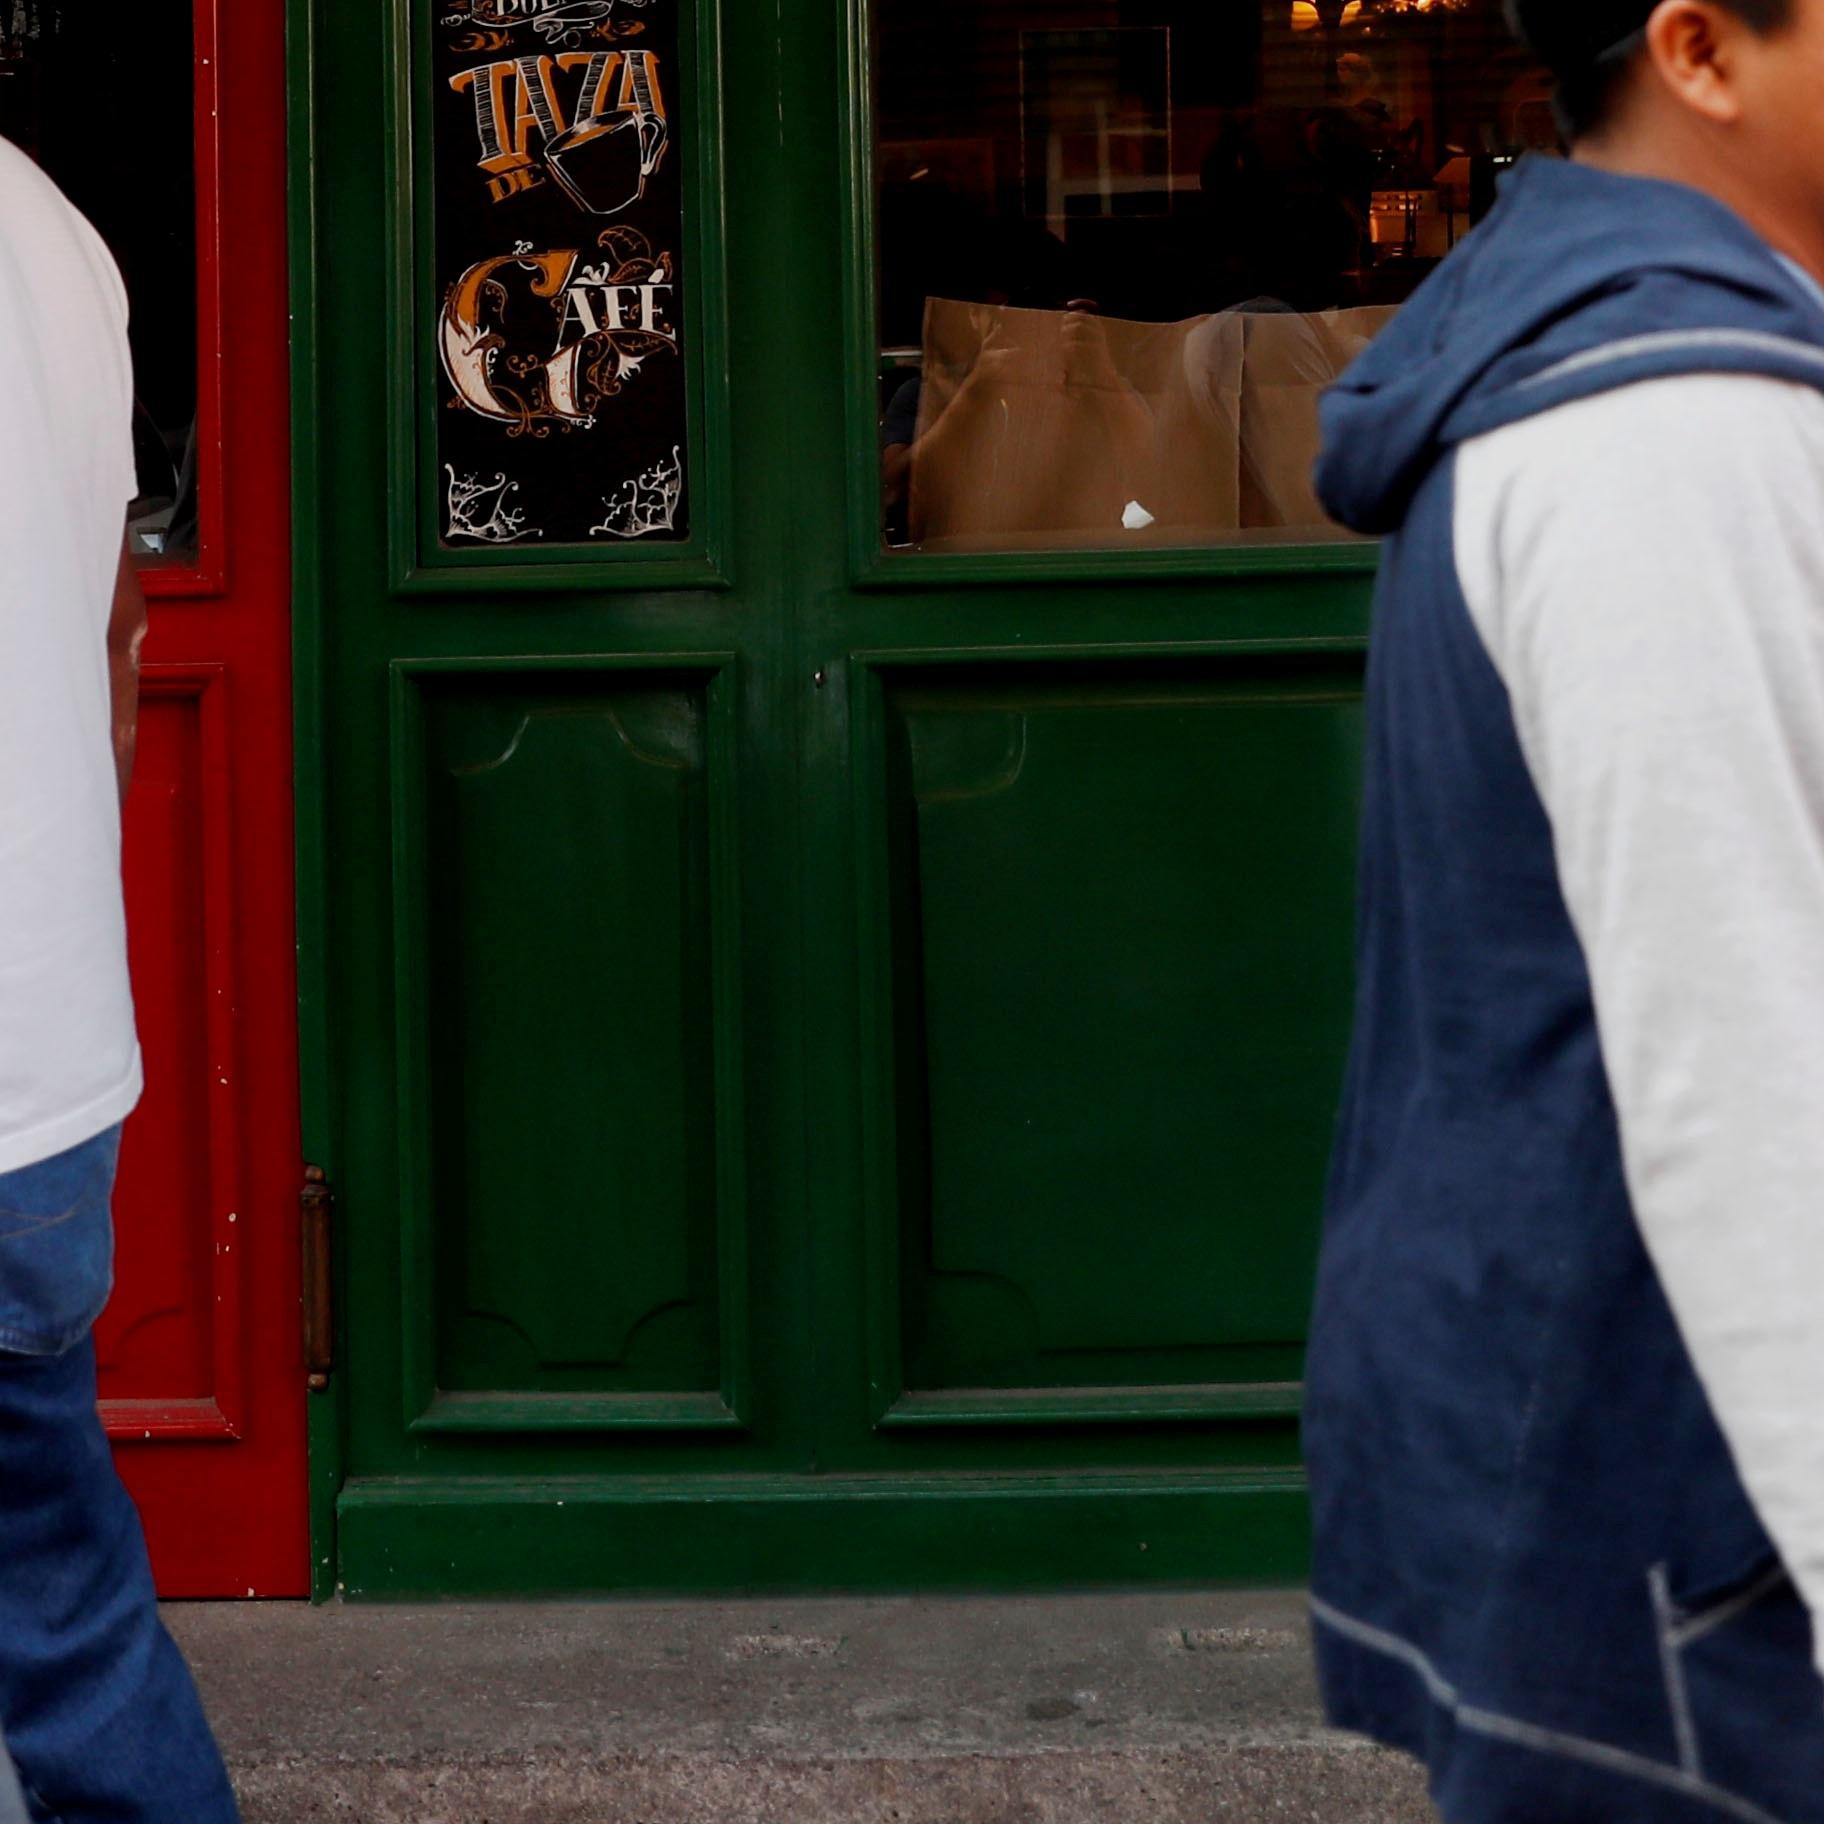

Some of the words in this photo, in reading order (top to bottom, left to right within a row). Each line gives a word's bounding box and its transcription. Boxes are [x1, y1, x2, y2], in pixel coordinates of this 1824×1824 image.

[448, 49, 667, 173] TAZA
[485, 163, 546, 204] DE
[438, 249, 677, 423] CAFÉ
